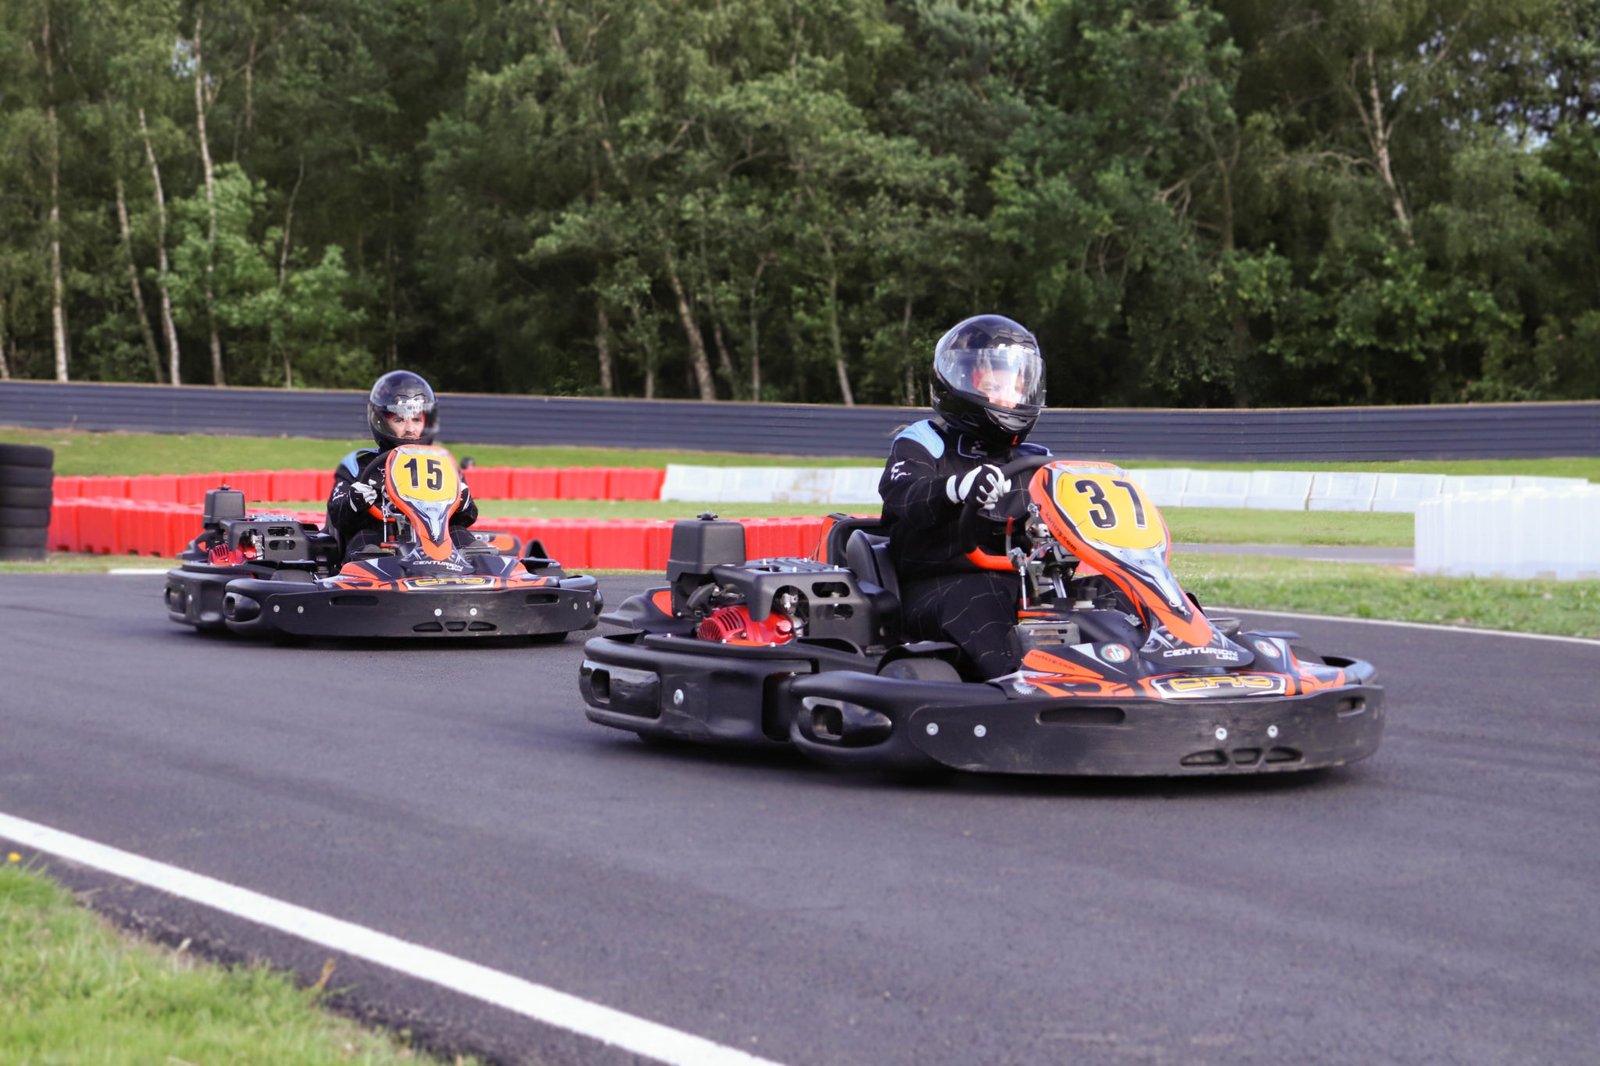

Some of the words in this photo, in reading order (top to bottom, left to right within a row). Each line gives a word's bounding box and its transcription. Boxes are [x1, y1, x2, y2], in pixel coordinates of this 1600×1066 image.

[403, 458, 443, 491] 15
[1075, 478, 1148, 529] 37
[1162, 646, 1239, 658] CENTURION
[1215, 654, 1239, 662] LINE
